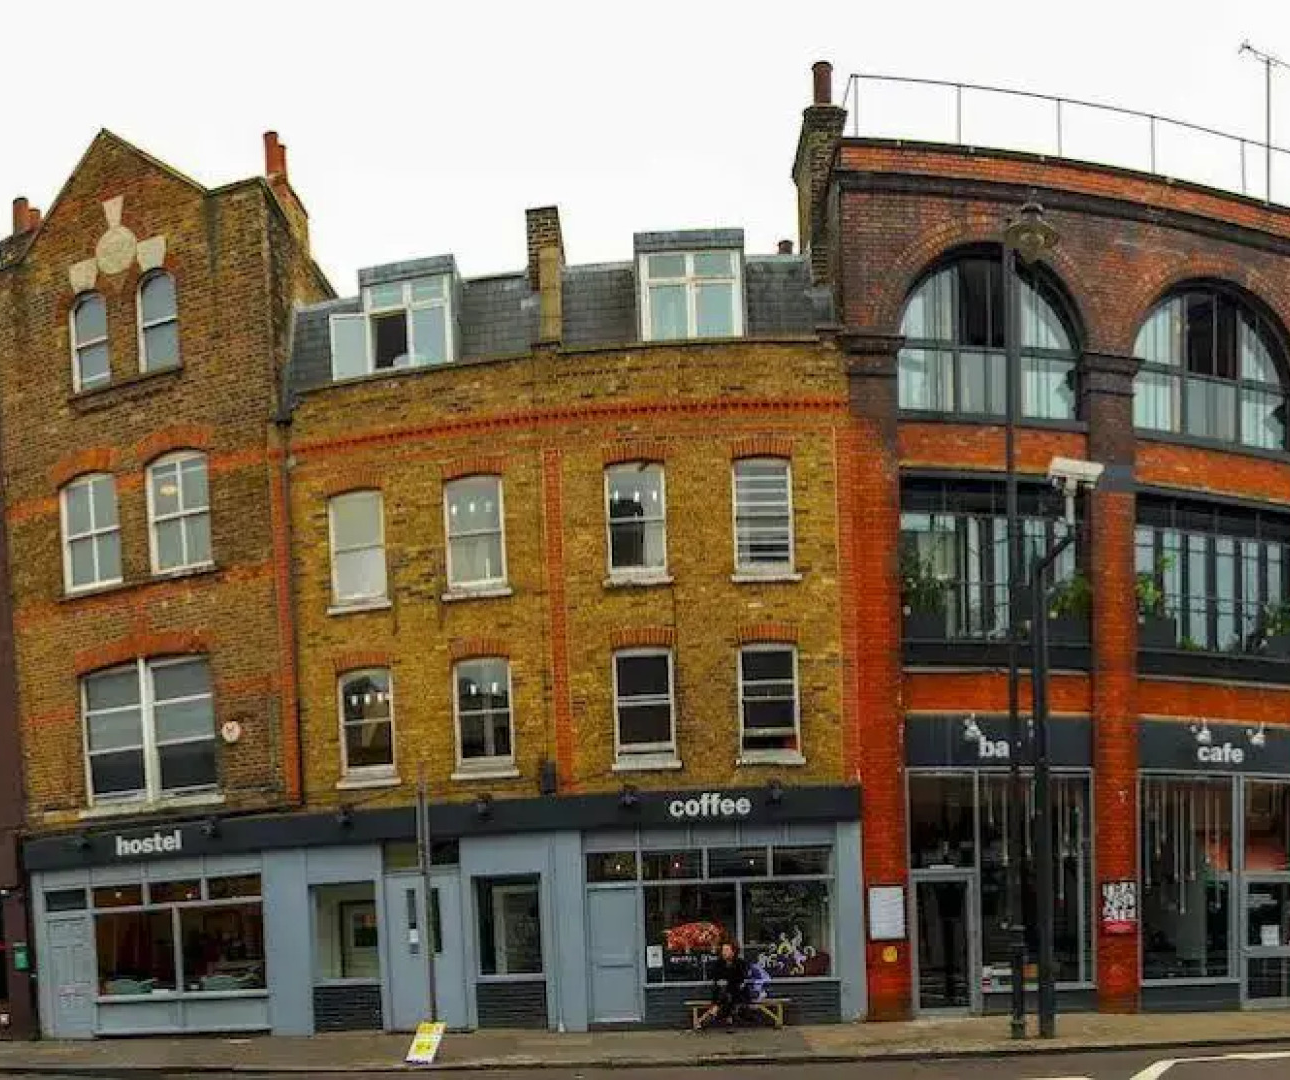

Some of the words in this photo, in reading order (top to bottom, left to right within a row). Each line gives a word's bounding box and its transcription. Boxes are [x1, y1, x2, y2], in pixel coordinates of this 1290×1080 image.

[979, 735, 1021, 758] ba
[1197, 742, 1244, 764] cafe
[670, 793, 751, 817] coffee
[115, 829, 183, 856] hostel
